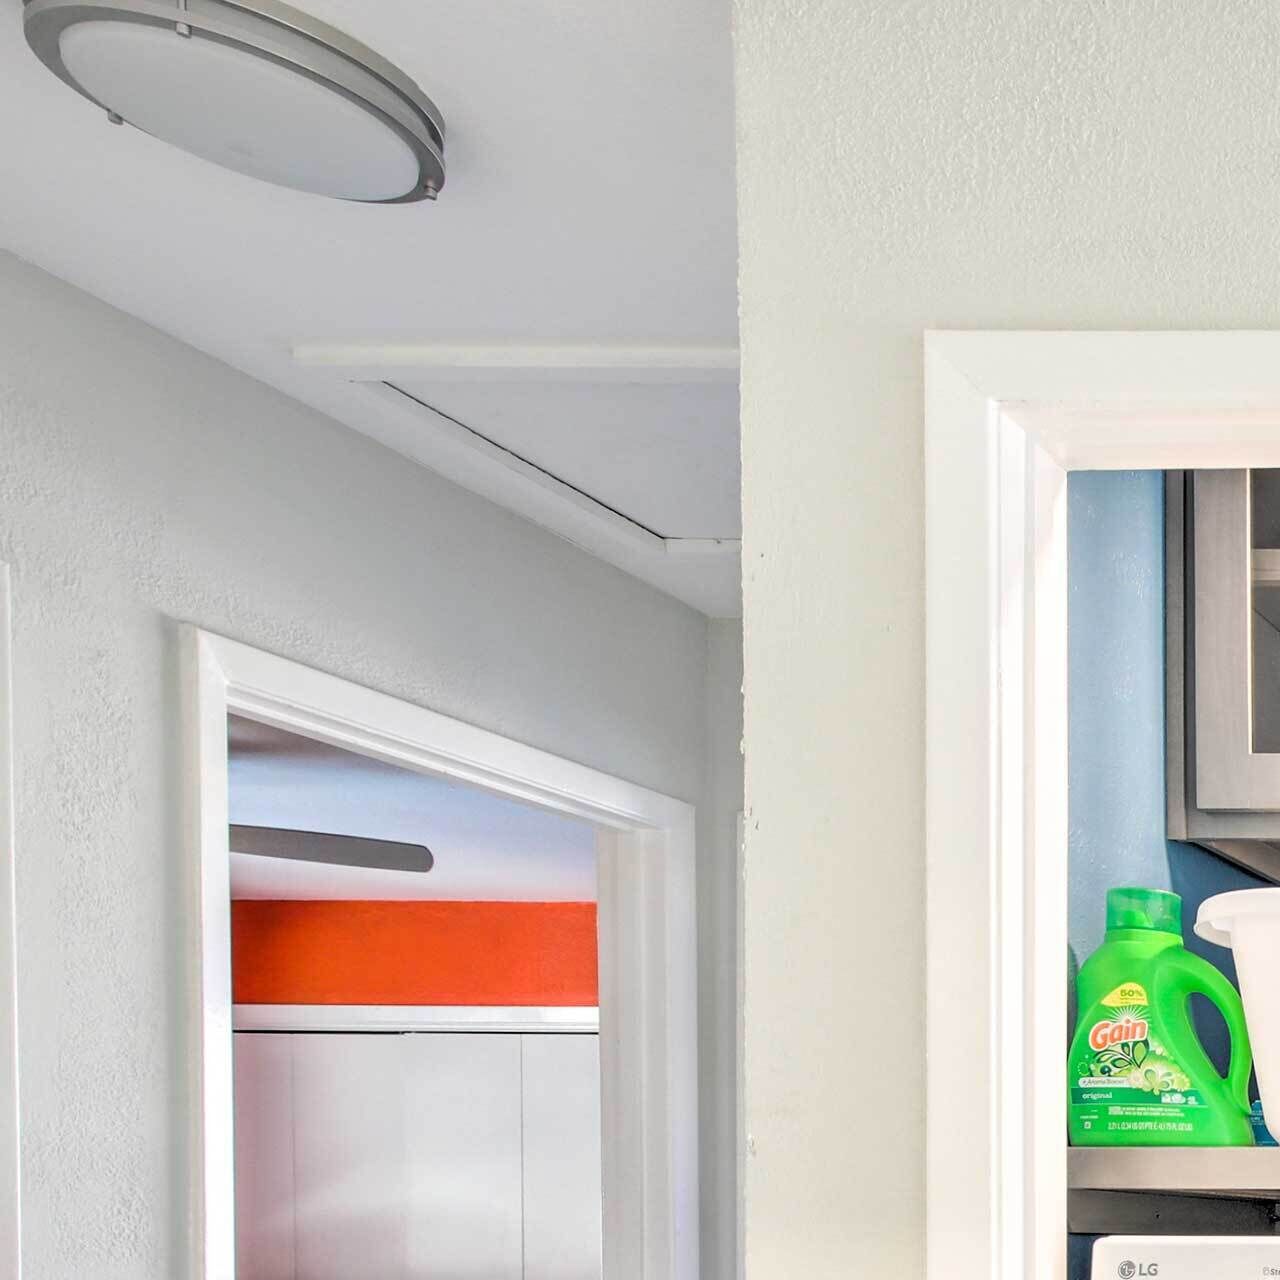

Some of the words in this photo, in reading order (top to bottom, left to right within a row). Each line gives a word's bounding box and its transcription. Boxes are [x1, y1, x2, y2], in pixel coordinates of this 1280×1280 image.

[1090, 1019, 1147, 1050] Gain
[1082, 1092, 1112, 1100] original
[1139, 1263, 1158, 1276] LG
